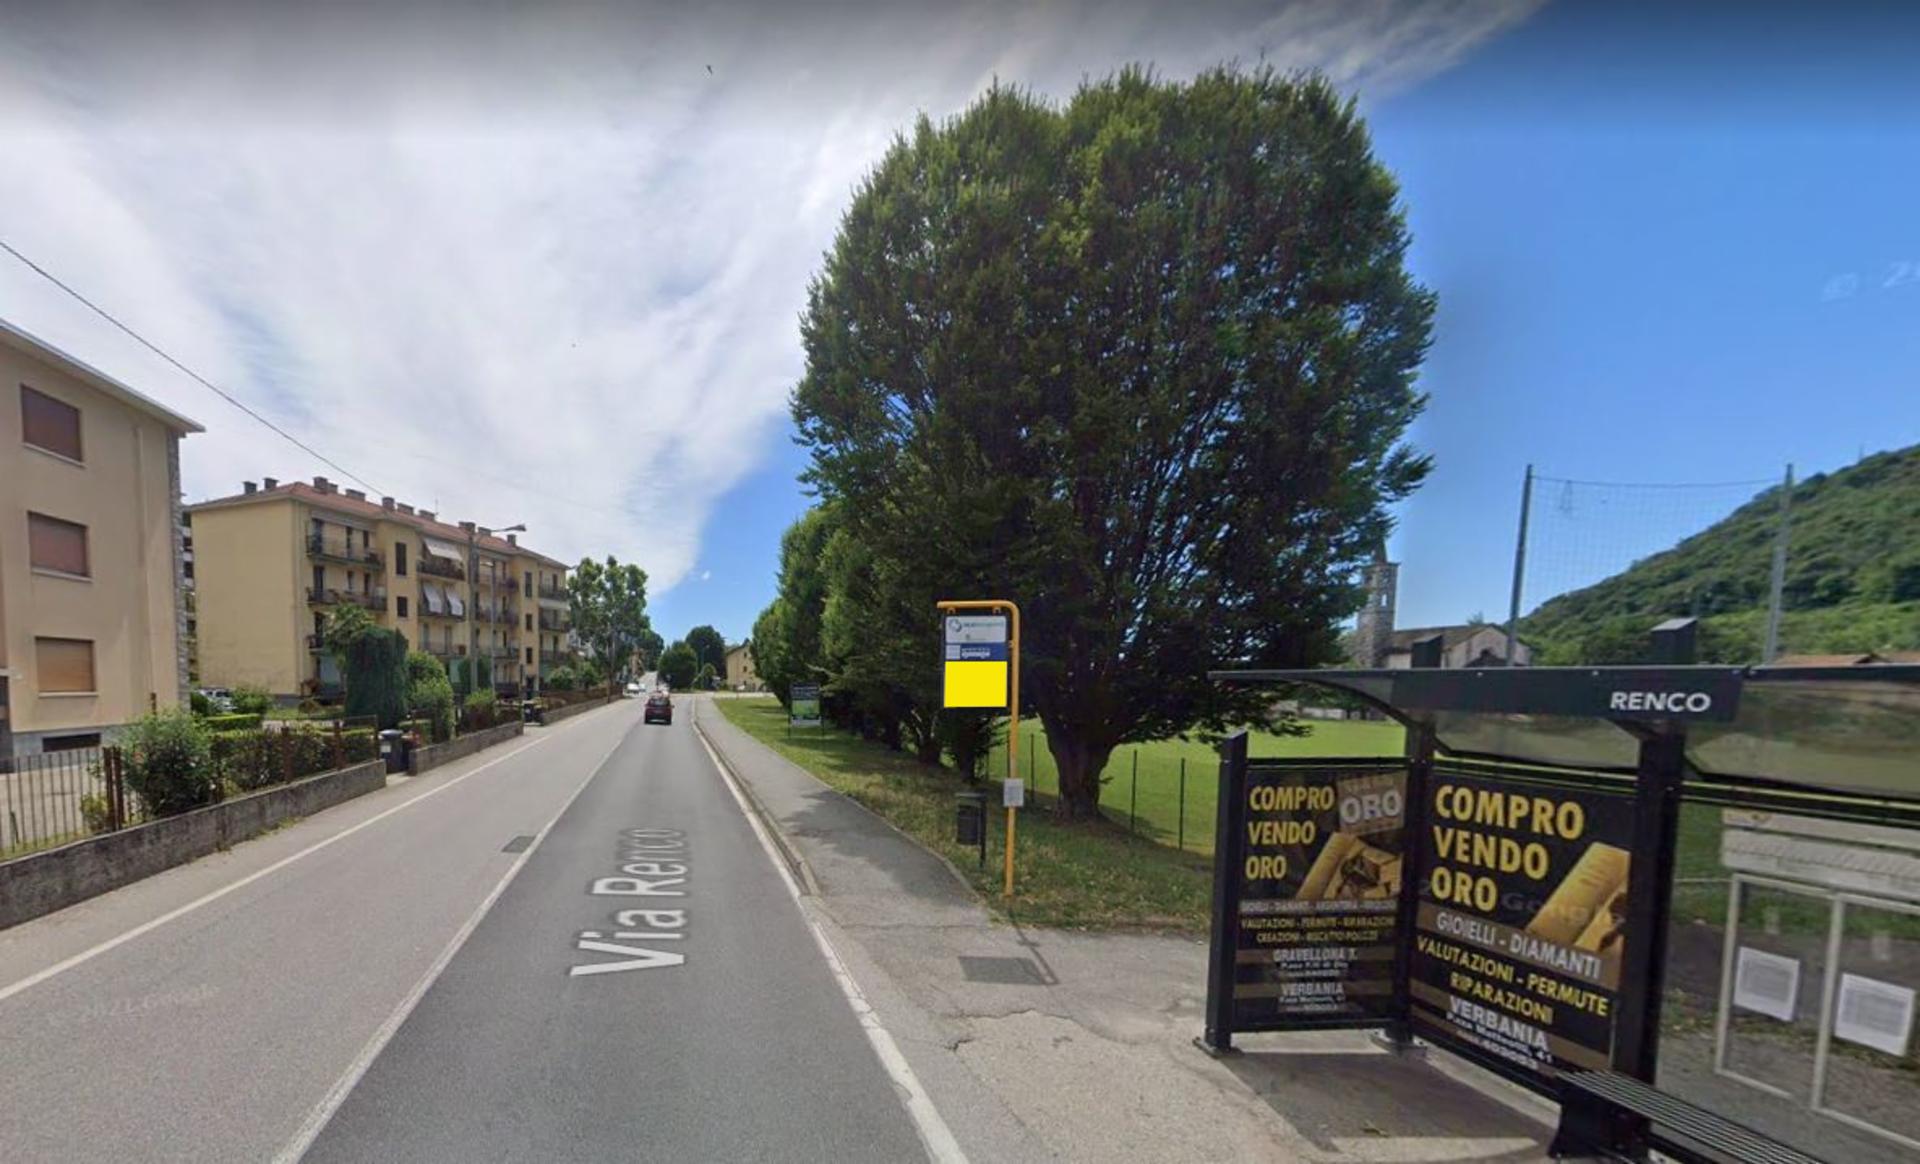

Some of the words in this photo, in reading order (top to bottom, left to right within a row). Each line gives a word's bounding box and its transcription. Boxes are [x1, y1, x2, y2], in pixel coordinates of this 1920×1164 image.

[1610, 691, 1711, 713] RENCO
[1249, 786, 1335, 811] COMPRO
[1340, 790, 1400, 824] ORO
[1435, 784, 1584, 840] COMPRO
[1248, 820, 1315, 845] VENDO
[1433, 825, 1548, 880] VENDO
[592, 828, 688, 896] Renco
[1245, 855, 1287, 880] ORO
[1431, 866, 1497, 912] ORO
[569, 909, 688, 977] Via
[1436, 912, 1495, 945] GIOIELLI
[1510, 934, 1601, 979] DIAMANTI
[1281, 981, 1344, 996] VERBANIA
[1416, 935, 1514, 982] VALUTAZIONI
[1527, 973, 1608, 1017] PERMUTE
[1451, 972, 1553, 1025] RIPARAZIONI
[1449, 994, 1549, 1053] VERBANIA
